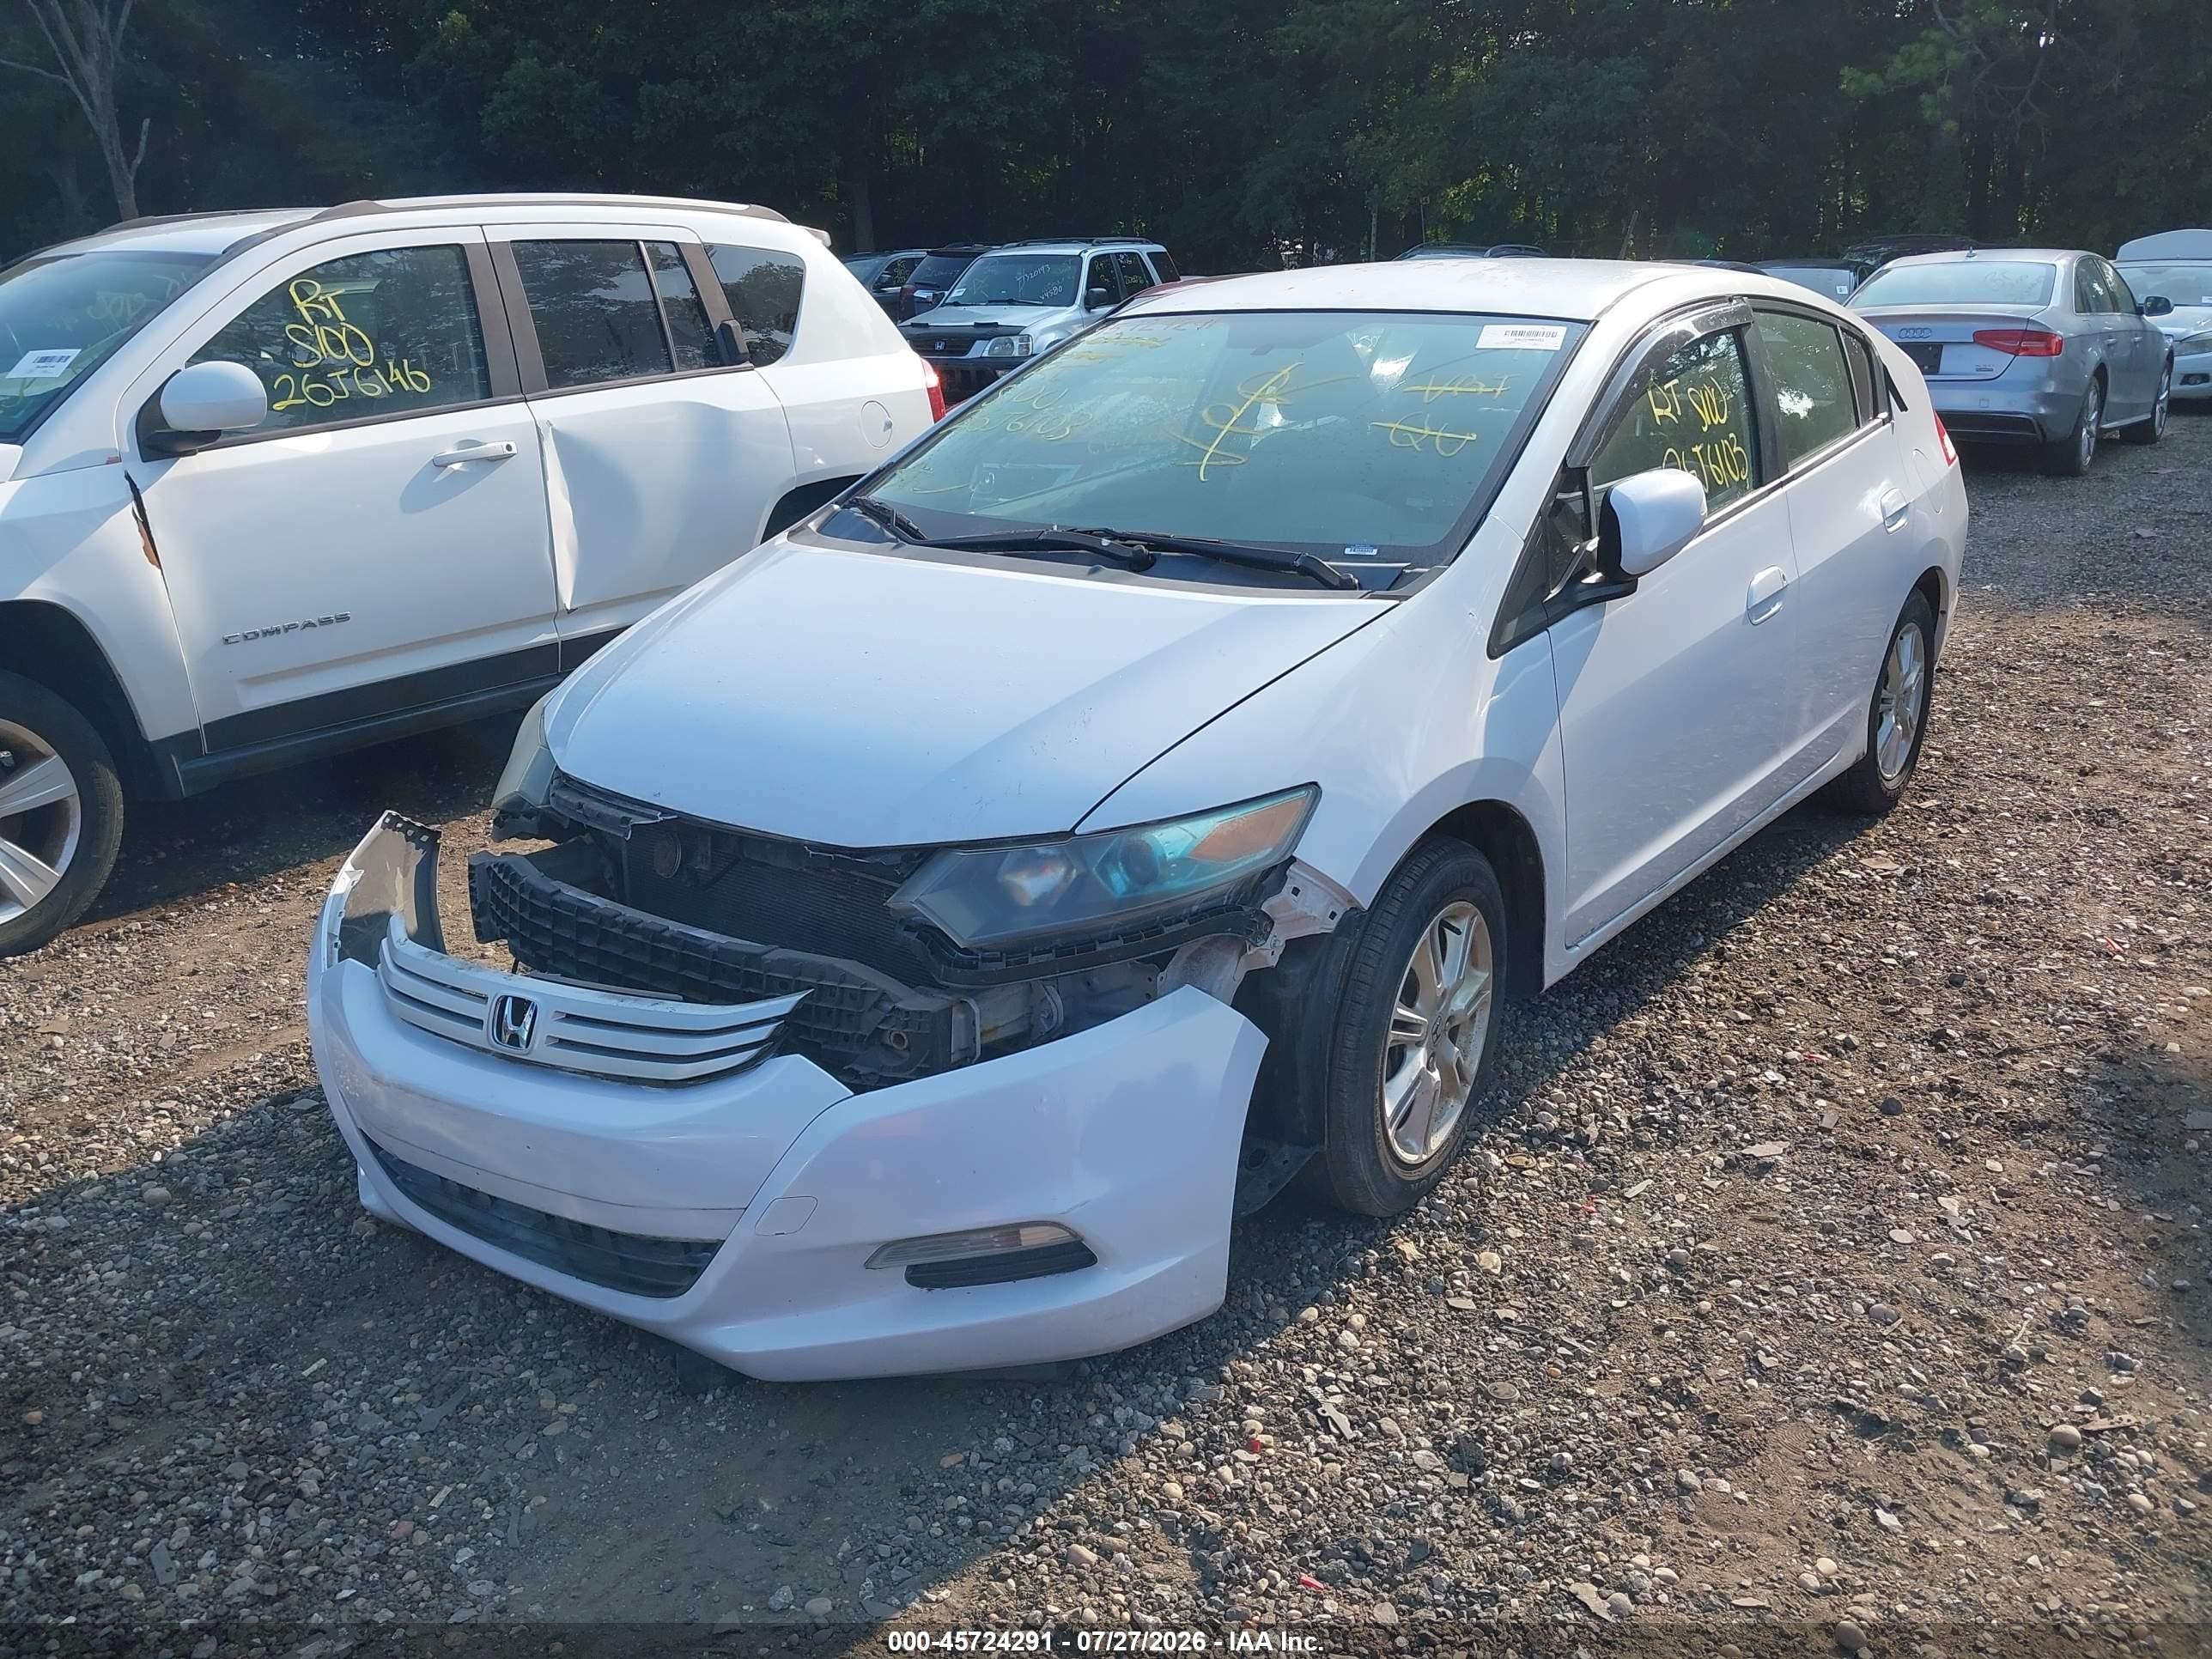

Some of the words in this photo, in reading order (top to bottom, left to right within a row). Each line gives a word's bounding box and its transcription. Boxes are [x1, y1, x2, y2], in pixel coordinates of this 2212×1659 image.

[289, 278, 346, 325] RT
[285, 322, 374, 368] S100
[272, 358, 431, 411] 26J6146
[1647, 378, 1682, 426] RT
[222, 611, 352, 646] COMPASS
